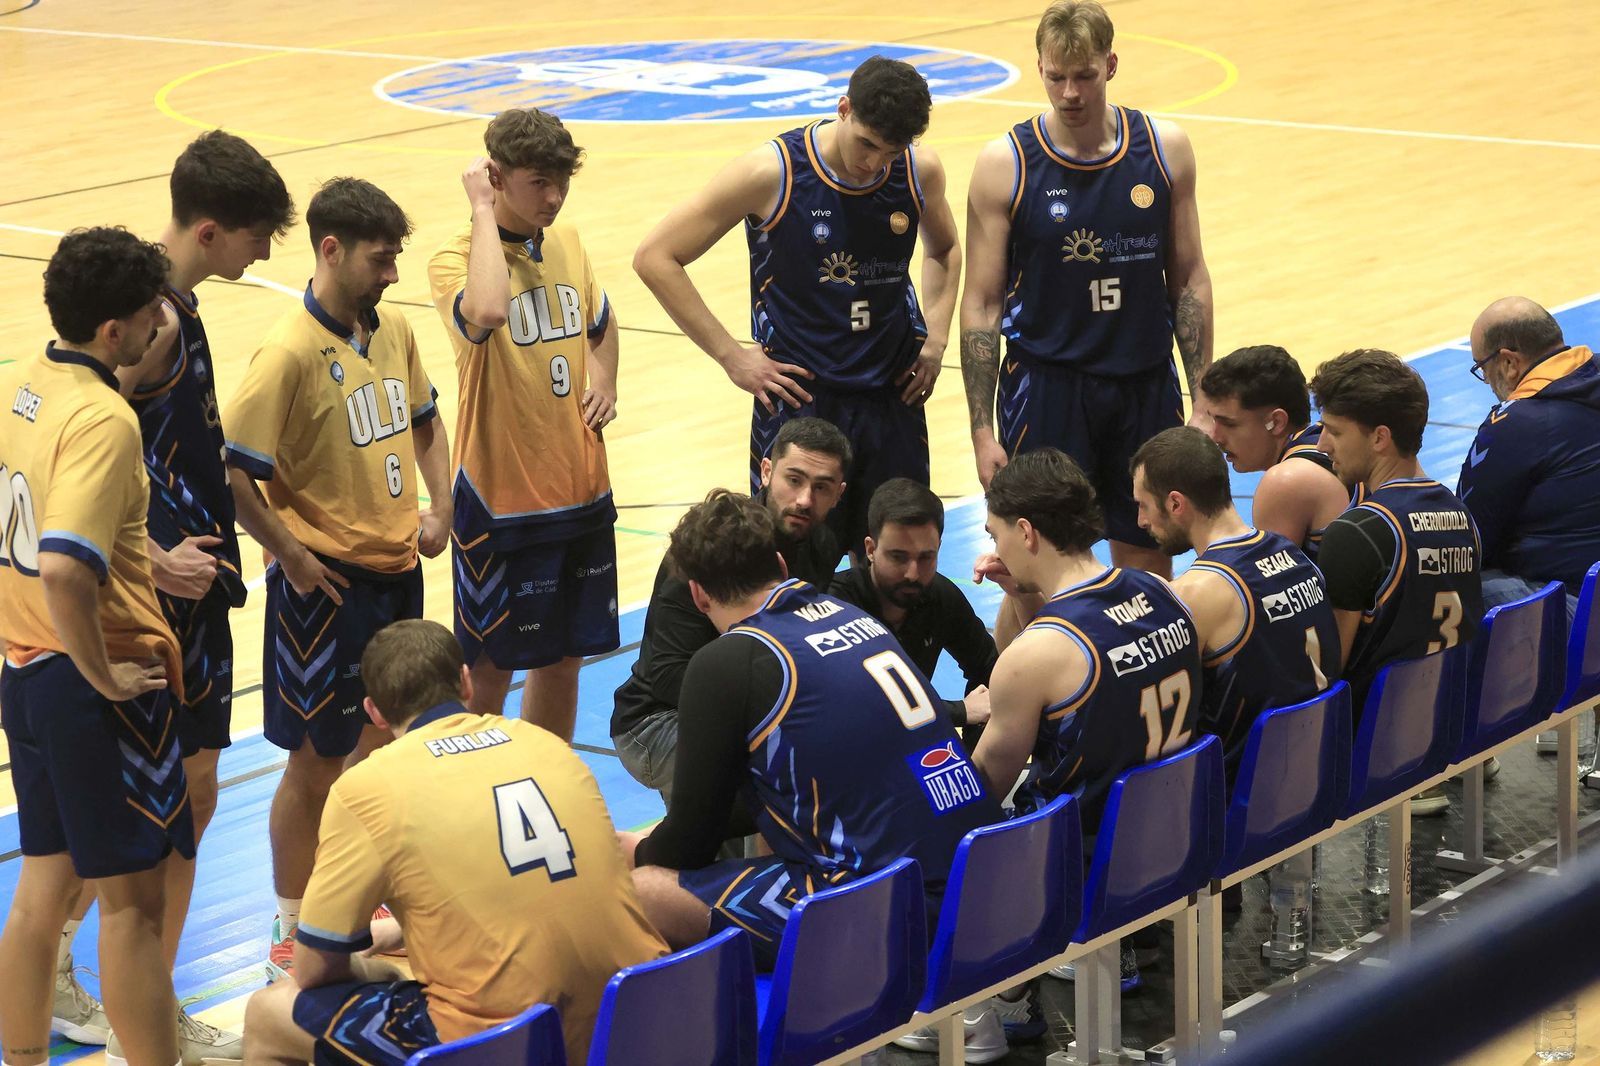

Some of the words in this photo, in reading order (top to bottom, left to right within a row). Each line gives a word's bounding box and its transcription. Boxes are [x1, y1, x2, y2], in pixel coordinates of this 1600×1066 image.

[810, 208, 832, 217] vive
[1045, 187, 1068, 197] vive
[1088, 276, 1122, 312] 15
[507, 283, 582, 347] ULB
[850, 300, 871, 332] 5
[549, 354, 571, 398] 9
[12, 382, 43, 423] LÓPEZ
[345, 377, 409, 448] ULB
[384, 452, 403, 498] 6
[1254, 549, 1298, 578] SEARA
[1441, 546, 1474, 574] STROG
[1103, 591, 1154, 626] YOME
[1286, 576, 1324, 613] STROG
[518, 622, 541, 633] vive
[1138, 618, 1191, 665] STROG
[1425, 590, 1463, 656] 3
[862, 649, 937, 731] 0
[1139, 669, 1192, 763] 12
[424, 728, 512, 758] FURLAN
[926, 764, 981, 812] UBAGO
[492, 776, 578, 883] 4
